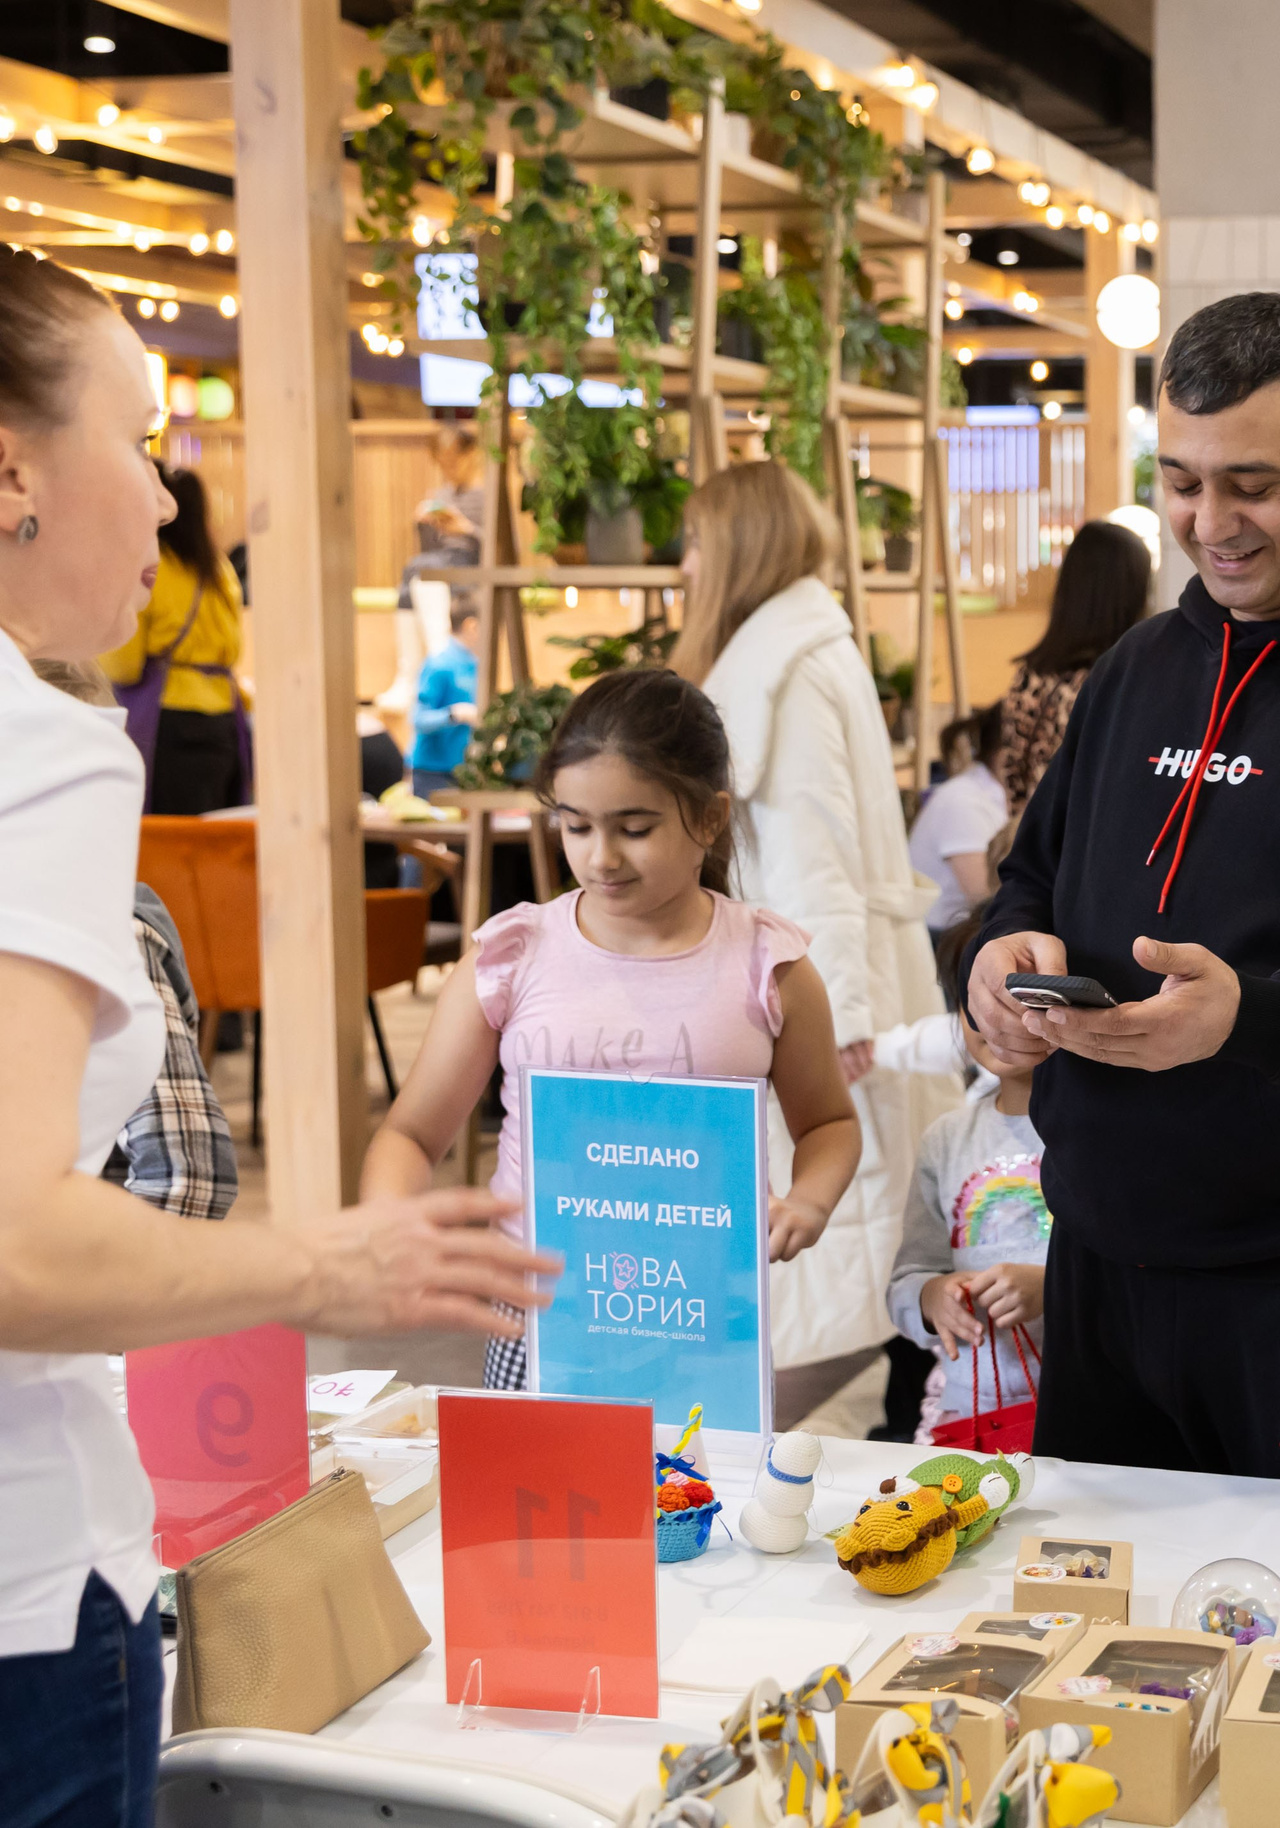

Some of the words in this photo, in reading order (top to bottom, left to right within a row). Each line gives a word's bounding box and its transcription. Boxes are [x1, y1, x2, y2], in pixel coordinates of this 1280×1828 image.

[1154, 747, 1252, 785] HUGO
[669, 1021, 694, 1074] A
[586, 1143, 700, 1169] СДЕЛАНО
[557, 1196, 649, 1222] РУКАМИ
[655, 1203, 732, 1228] ДЕТЕЙ
[587, 1290, 705, 1328] ТОРИЯ
[587, 1324, 629, 1335] детская
[631, 1326, 706, 1342] бизнес-школа
